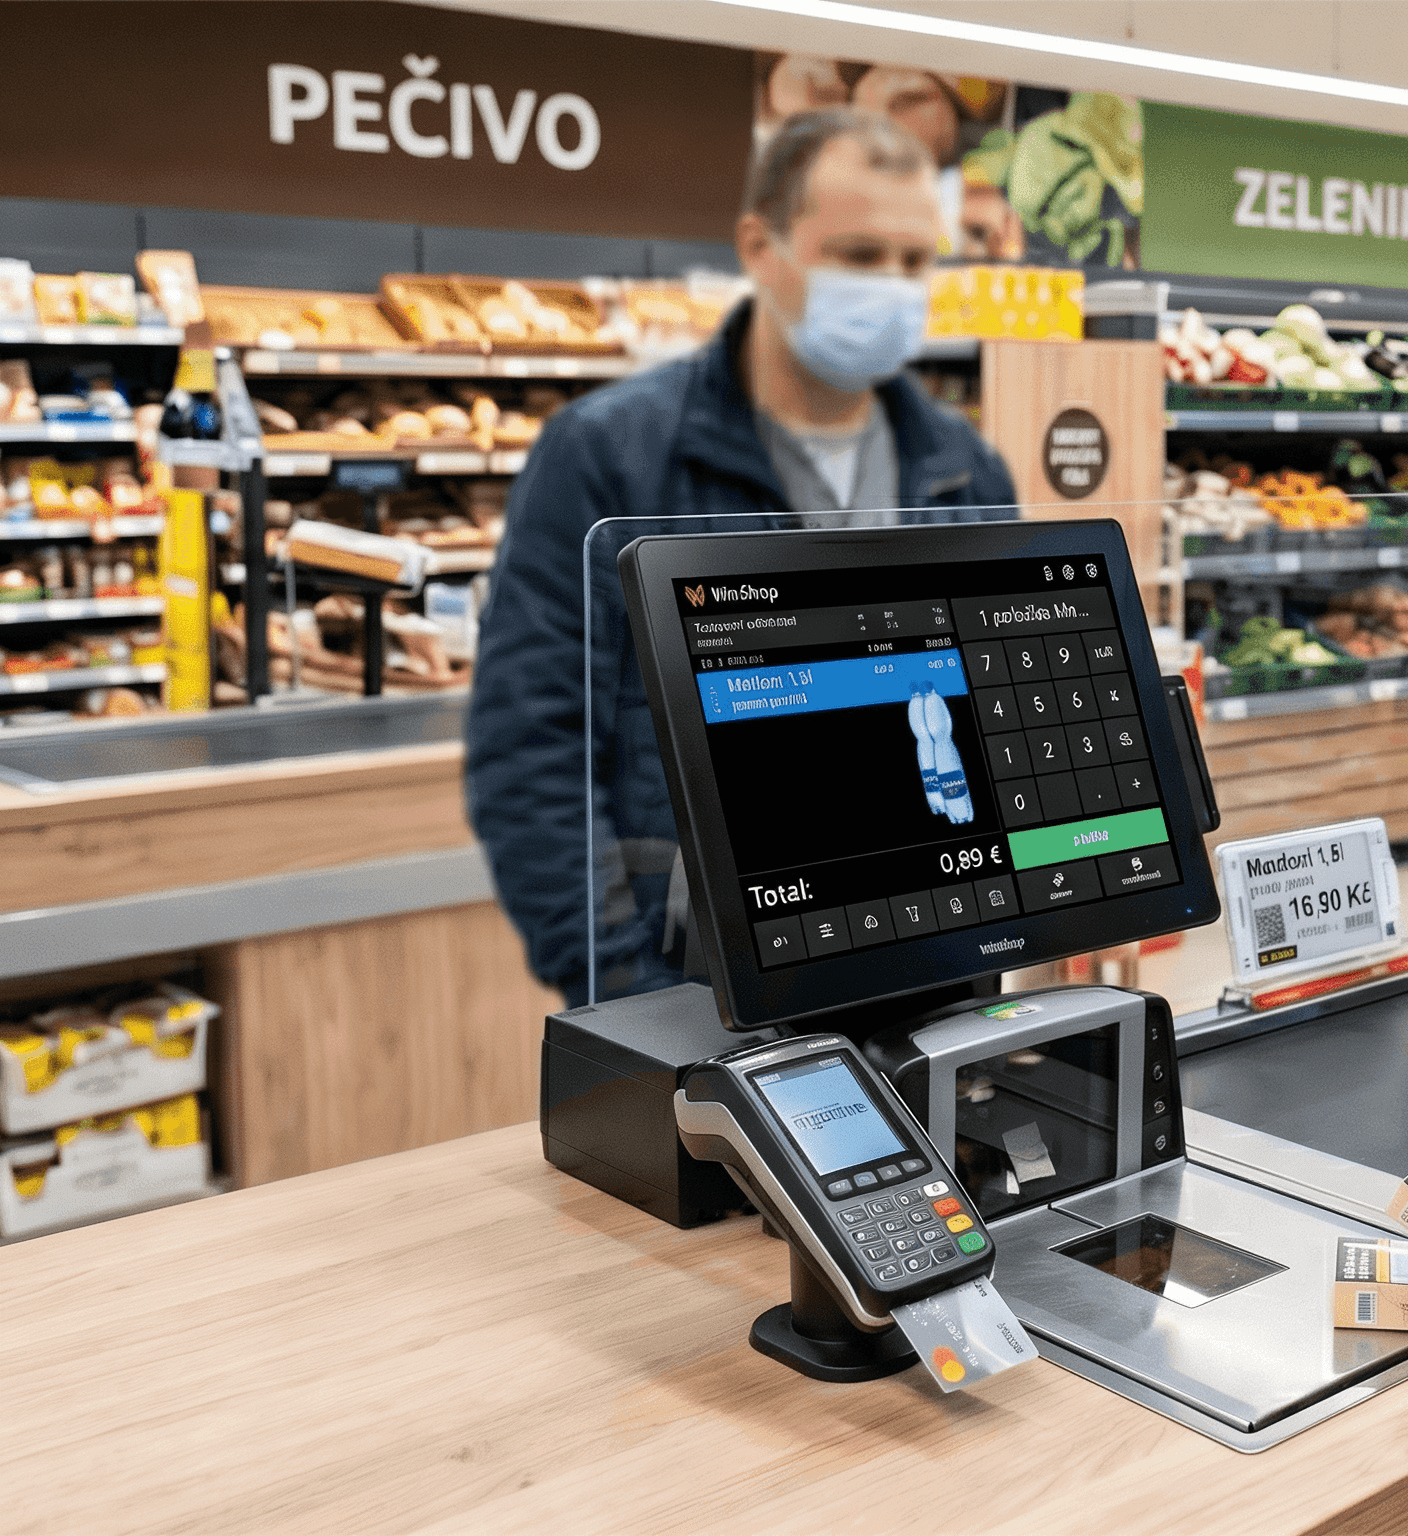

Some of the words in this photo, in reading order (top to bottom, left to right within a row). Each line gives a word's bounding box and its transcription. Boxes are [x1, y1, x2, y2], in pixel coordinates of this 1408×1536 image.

[267, 54, 601, 171] PEČIVO
[981, 654, 990, 672] 7
[1021, 651, 1033, 668] 8
[1058, 647, 1070, 664] 9
[1072, 691, 1082, 708] 6
[993, 700, 1004, 718] 4
[1004, 747, 1012, 764] 1
[1043, 741, 1055, 759] 2
[1014, 794, 1025, 810] 0
[748, 878, 813, 908] Total:
[940, 848, 983, 875] 0,89
[990, 845, 1003, 864] €
[1289, 888, 1341, 919] 16,90
